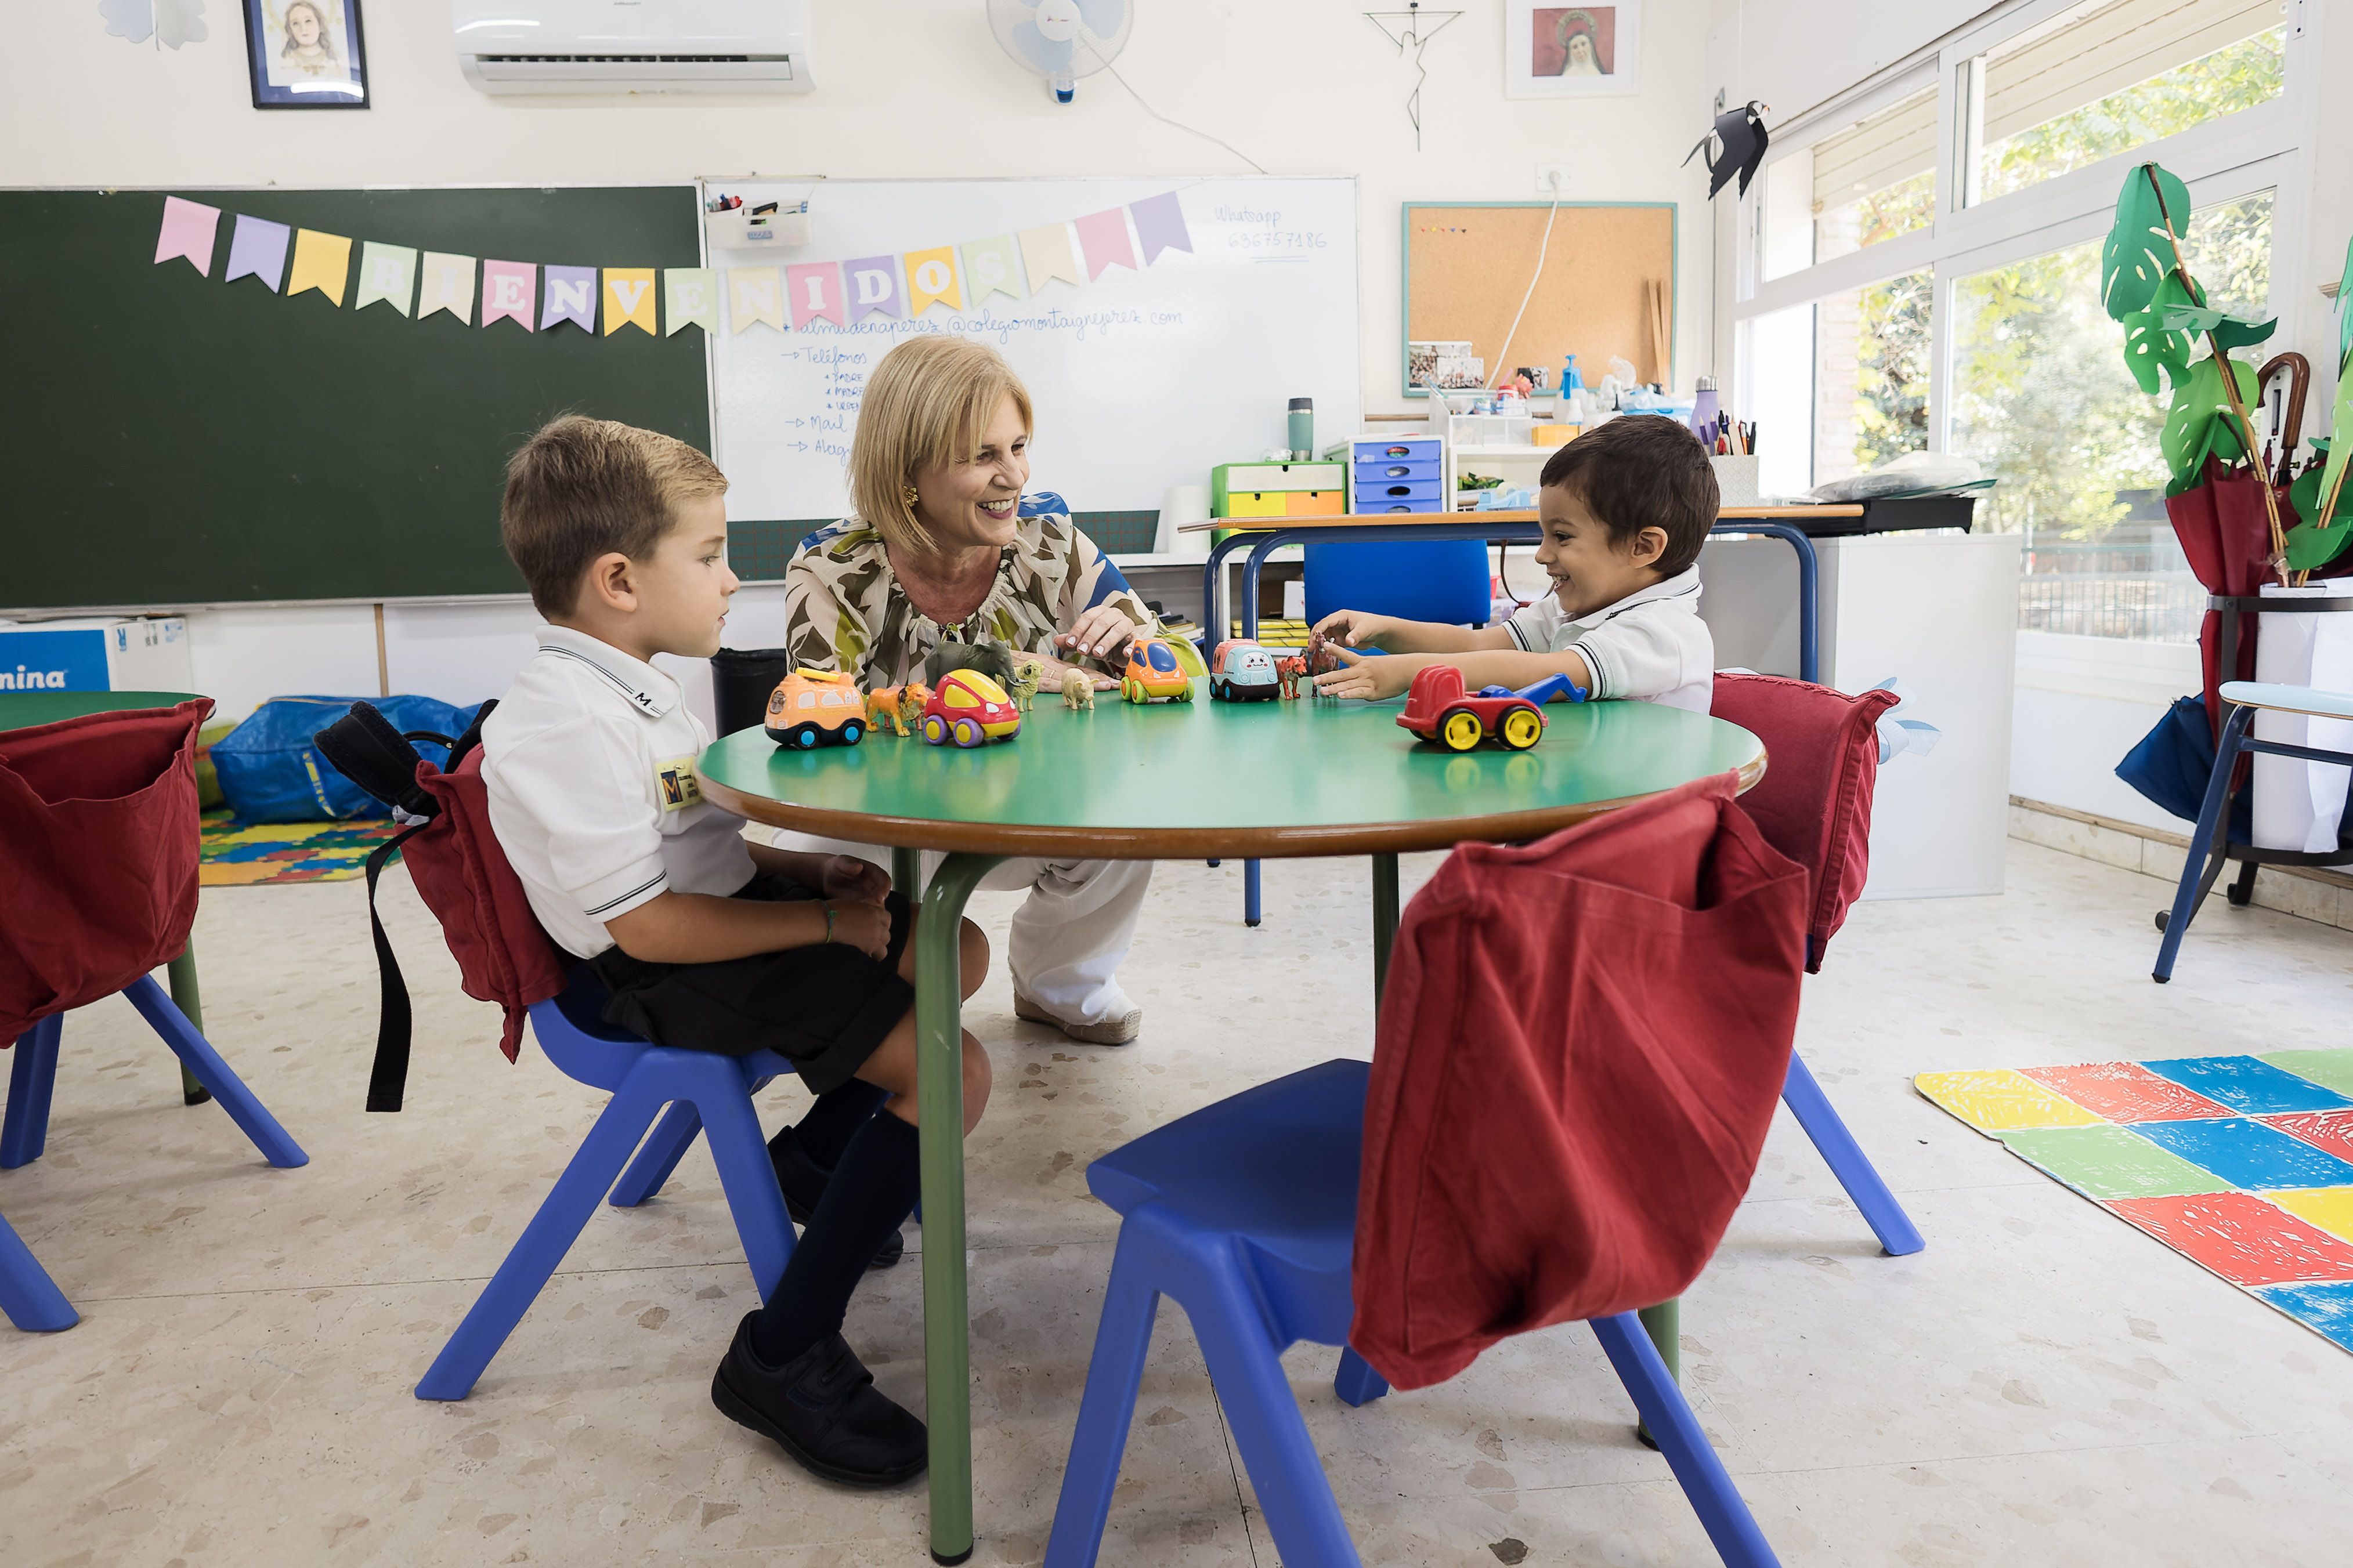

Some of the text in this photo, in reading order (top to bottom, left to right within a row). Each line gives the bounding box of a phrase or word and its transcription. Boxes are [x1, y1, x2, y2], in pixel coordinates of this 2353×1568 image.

[1215, 204, 1281, 229] Whatsapp
[799, 345, 867, 374] Teléfonos
[832, 372, 863, 383] PADRE
[810, 414, 847, 433] Mail
